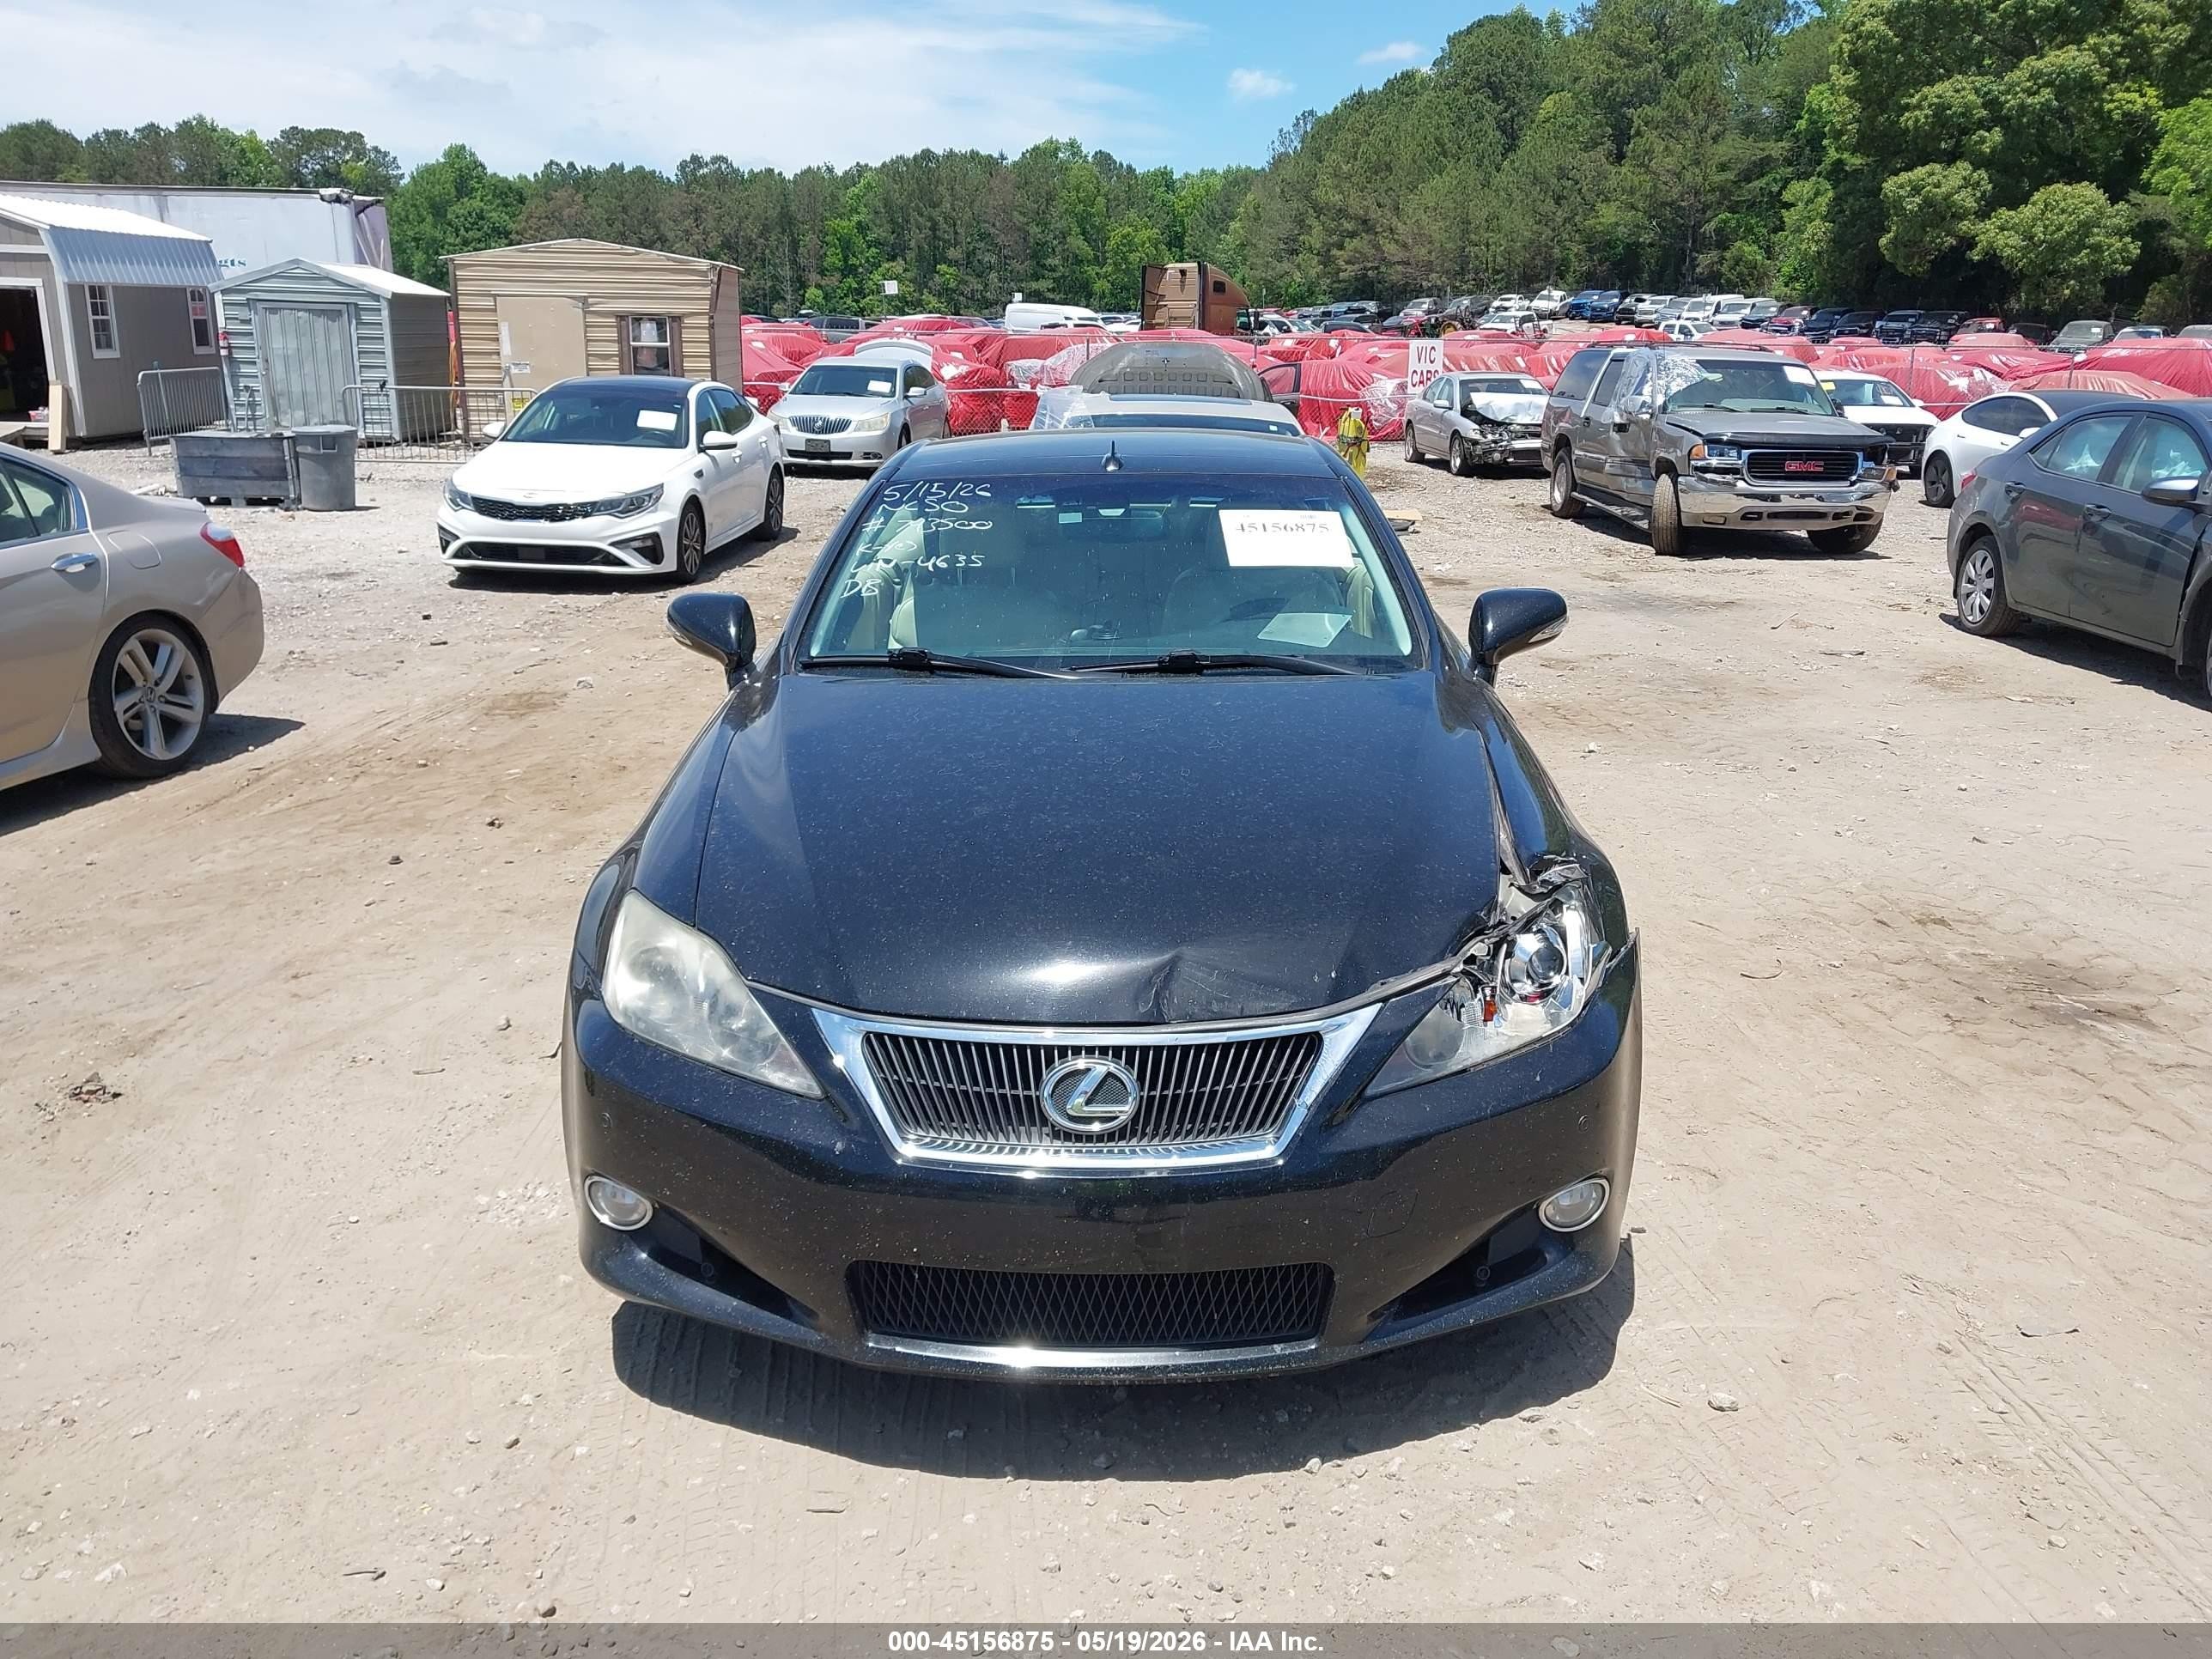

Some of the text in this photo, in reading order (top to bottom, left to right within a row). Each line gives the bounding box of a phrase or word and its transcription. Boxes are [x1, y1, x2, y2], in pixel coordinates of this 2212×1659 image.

[1417, 345, 1437, 364] VIC
[1785, 460, 1825, 471] GMC
[884, 480, 992, 501] 5/15/26
[1236, 522, 1329, 534] 45156875
